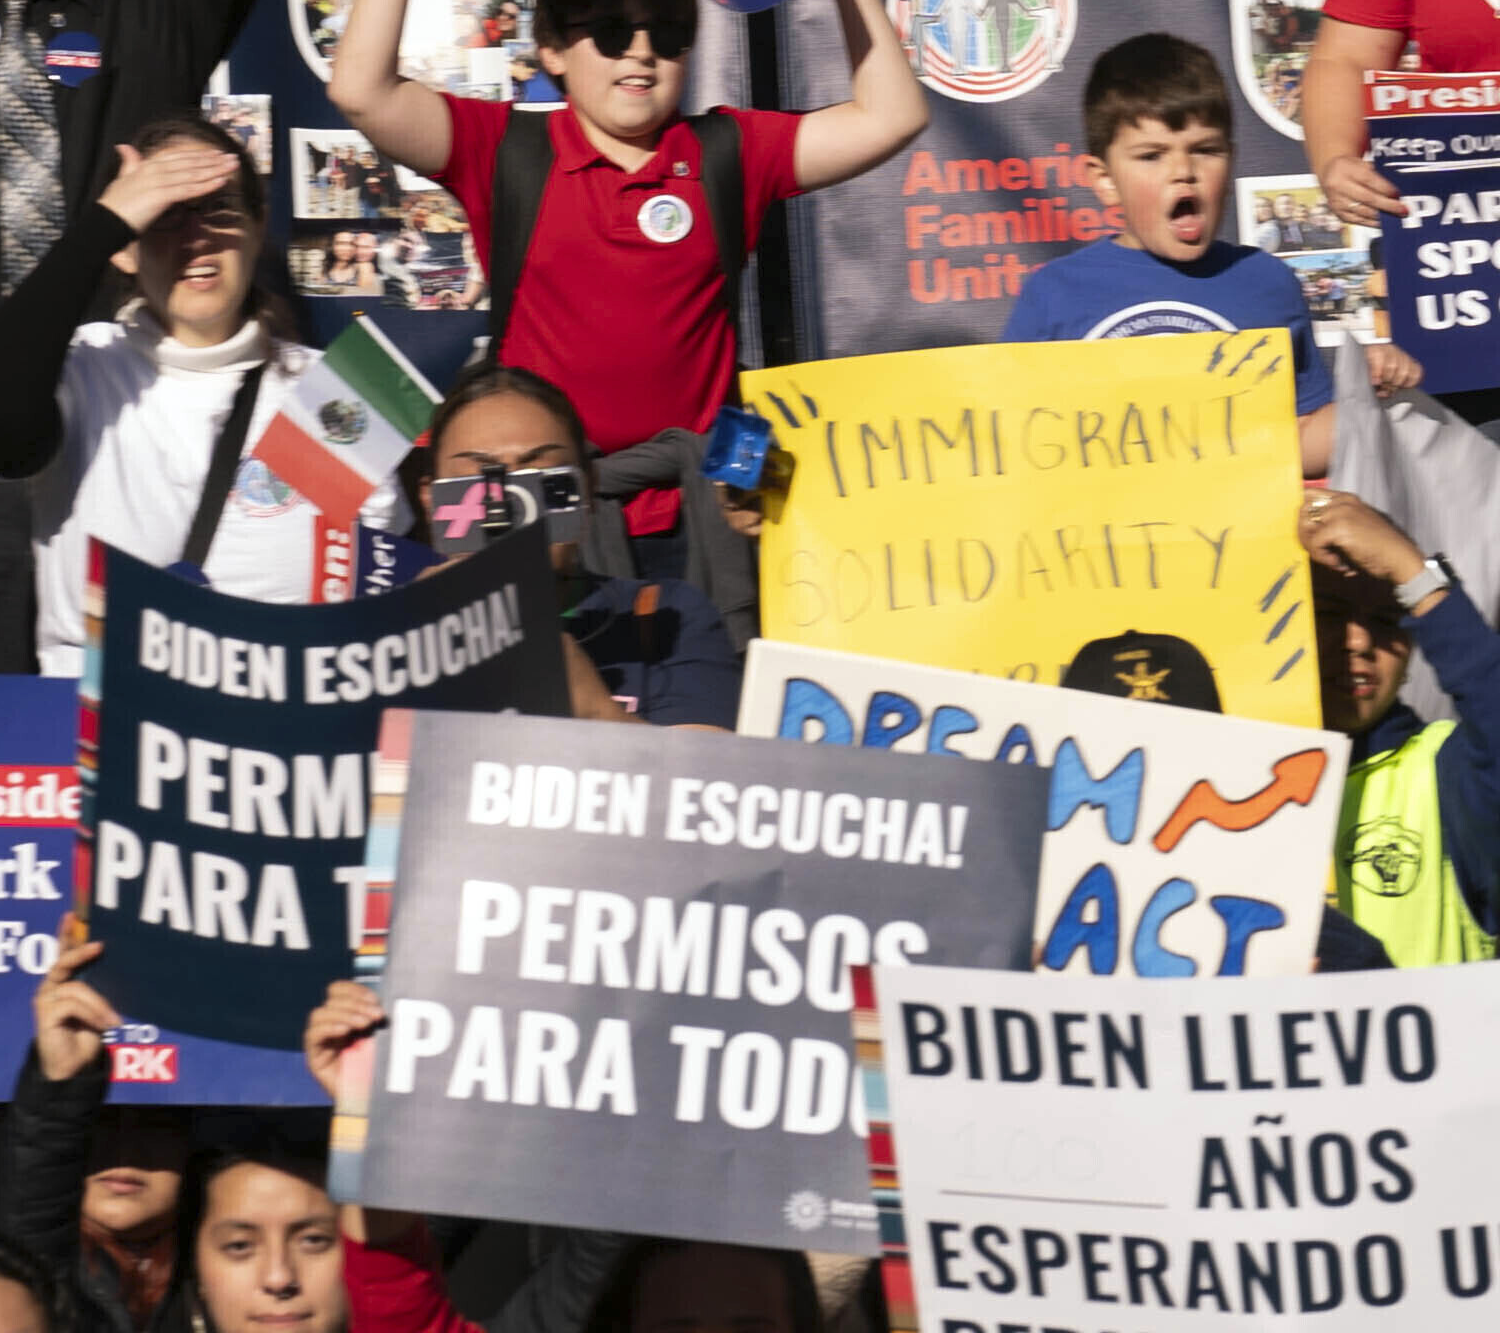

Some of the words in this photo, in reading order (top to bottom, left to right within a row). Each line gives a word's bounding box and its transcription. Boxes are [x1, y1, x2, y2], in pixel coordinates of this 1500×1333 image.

[1416, 289, 1491, 331] US
[824, 388, 1254, 499] IMMIGRANT
[781, 521, 1233, 628] SOLIDARITY
[140, 607, 287, 702] BIDEN
[305, 583, 524, 704] ESCUCHA!
[468, 761, 649, 837] BIDEN
[664, 778, 969, 869] ESCUCHA!
[95, 821, 310, 951] PARA
[1041, 861, 1286, 978] ACT
[899, 1000, 1149, 1090] BIDEN
[1185, 1004, 1437, 1092] LLEVO
[1196, 1113, 1414, 1211] AÑOS
[927, 1220, 1411, 1315] ESPERANDO
